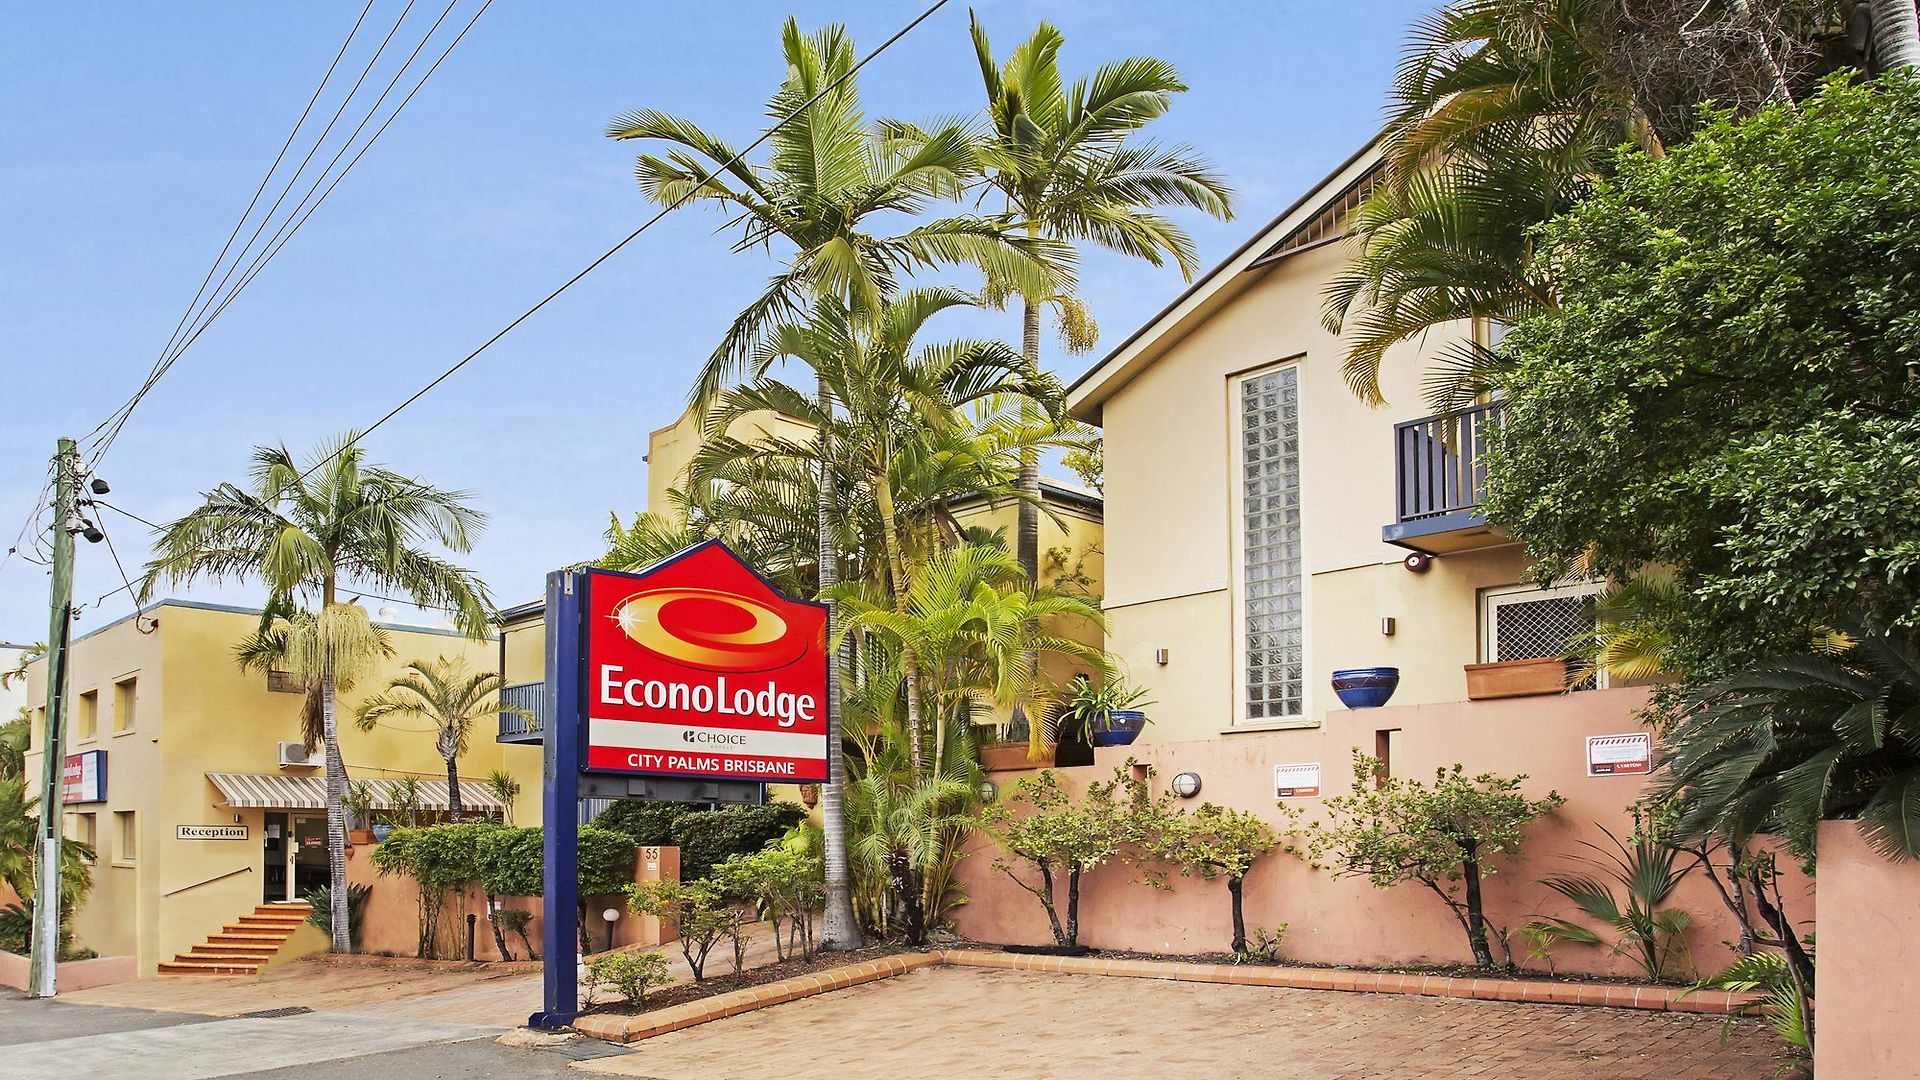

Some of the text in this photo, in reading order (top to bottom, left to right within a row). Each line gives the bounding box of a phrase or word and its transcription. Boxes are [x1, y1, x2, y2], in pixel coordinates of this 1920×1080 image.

[601, 664, 815, 727] EconoLodge
[697, 732, 747, 745] CHOICE
[628, 753, 796, 775] CITY PALMS BRISBANE
[182, 827, 244, 837] Reception
[645, 848, 659, 860] 55
